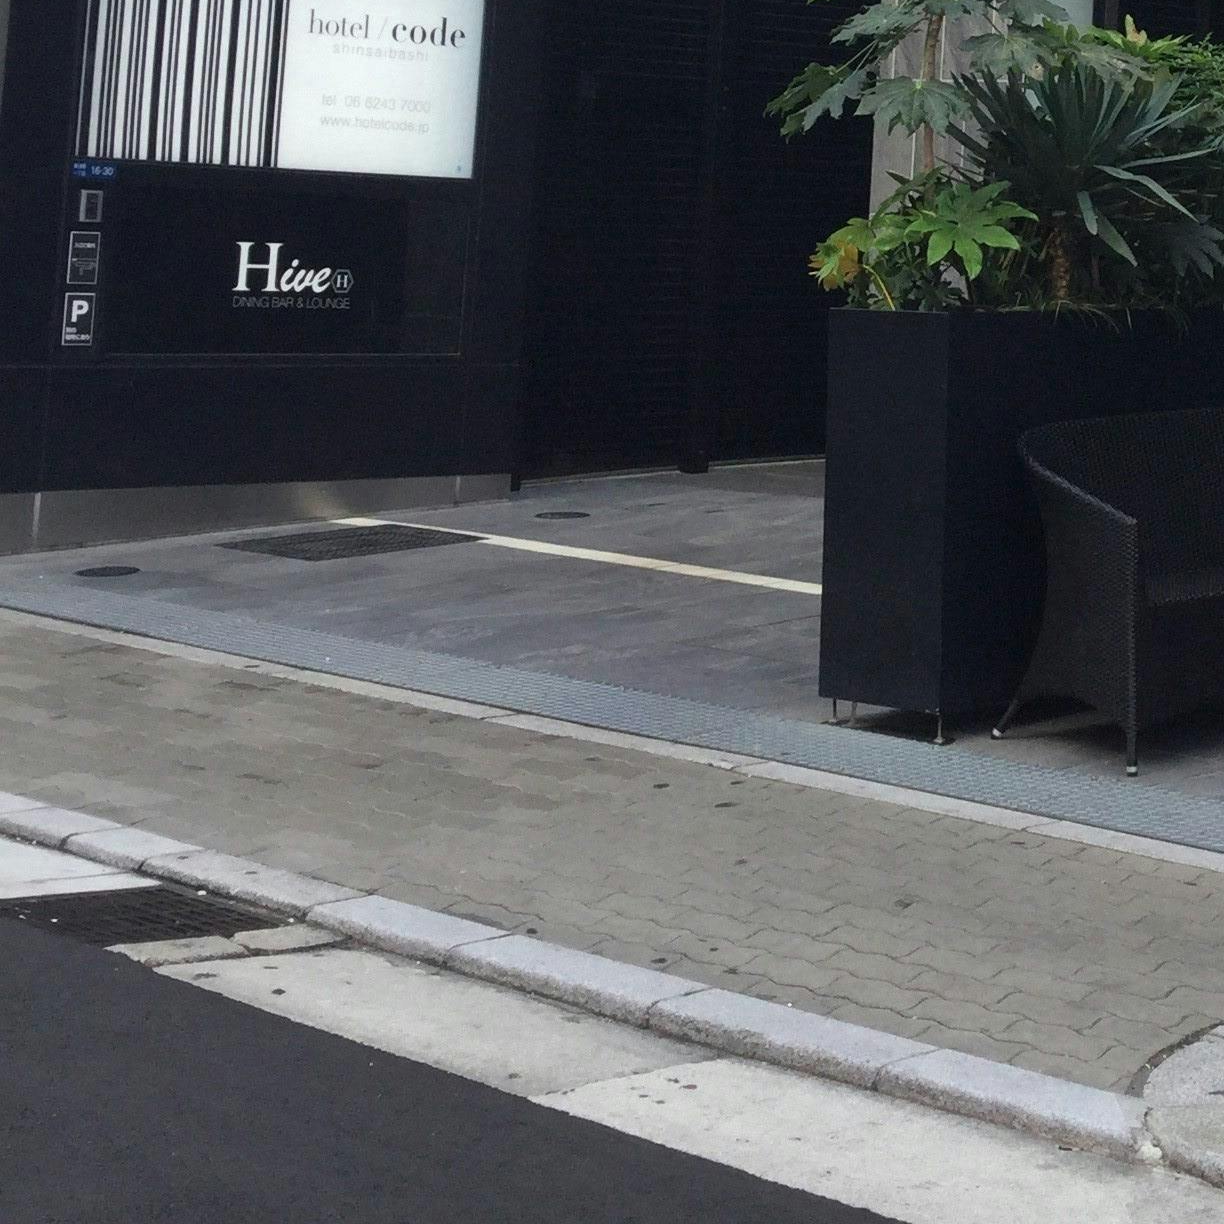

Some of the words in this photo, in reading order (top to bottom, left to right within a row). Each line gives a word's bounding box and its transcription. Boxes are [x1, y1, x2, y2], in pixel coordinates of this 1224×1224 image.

[308, 8, 370, 39] hotel
[332, 42, 429, 62] shinsaibashi
[322, 93, 337, 107] tel
[320, 113, 431, 136] www.hotelcode.jp
[231, 241, 333, 294] Hive
[71, 299, 89, 323] P
[232, 295, 270, 309] DINING
[271, 296, 294, 309] BAR
[305, 296, 350, 310] LOUNGE
